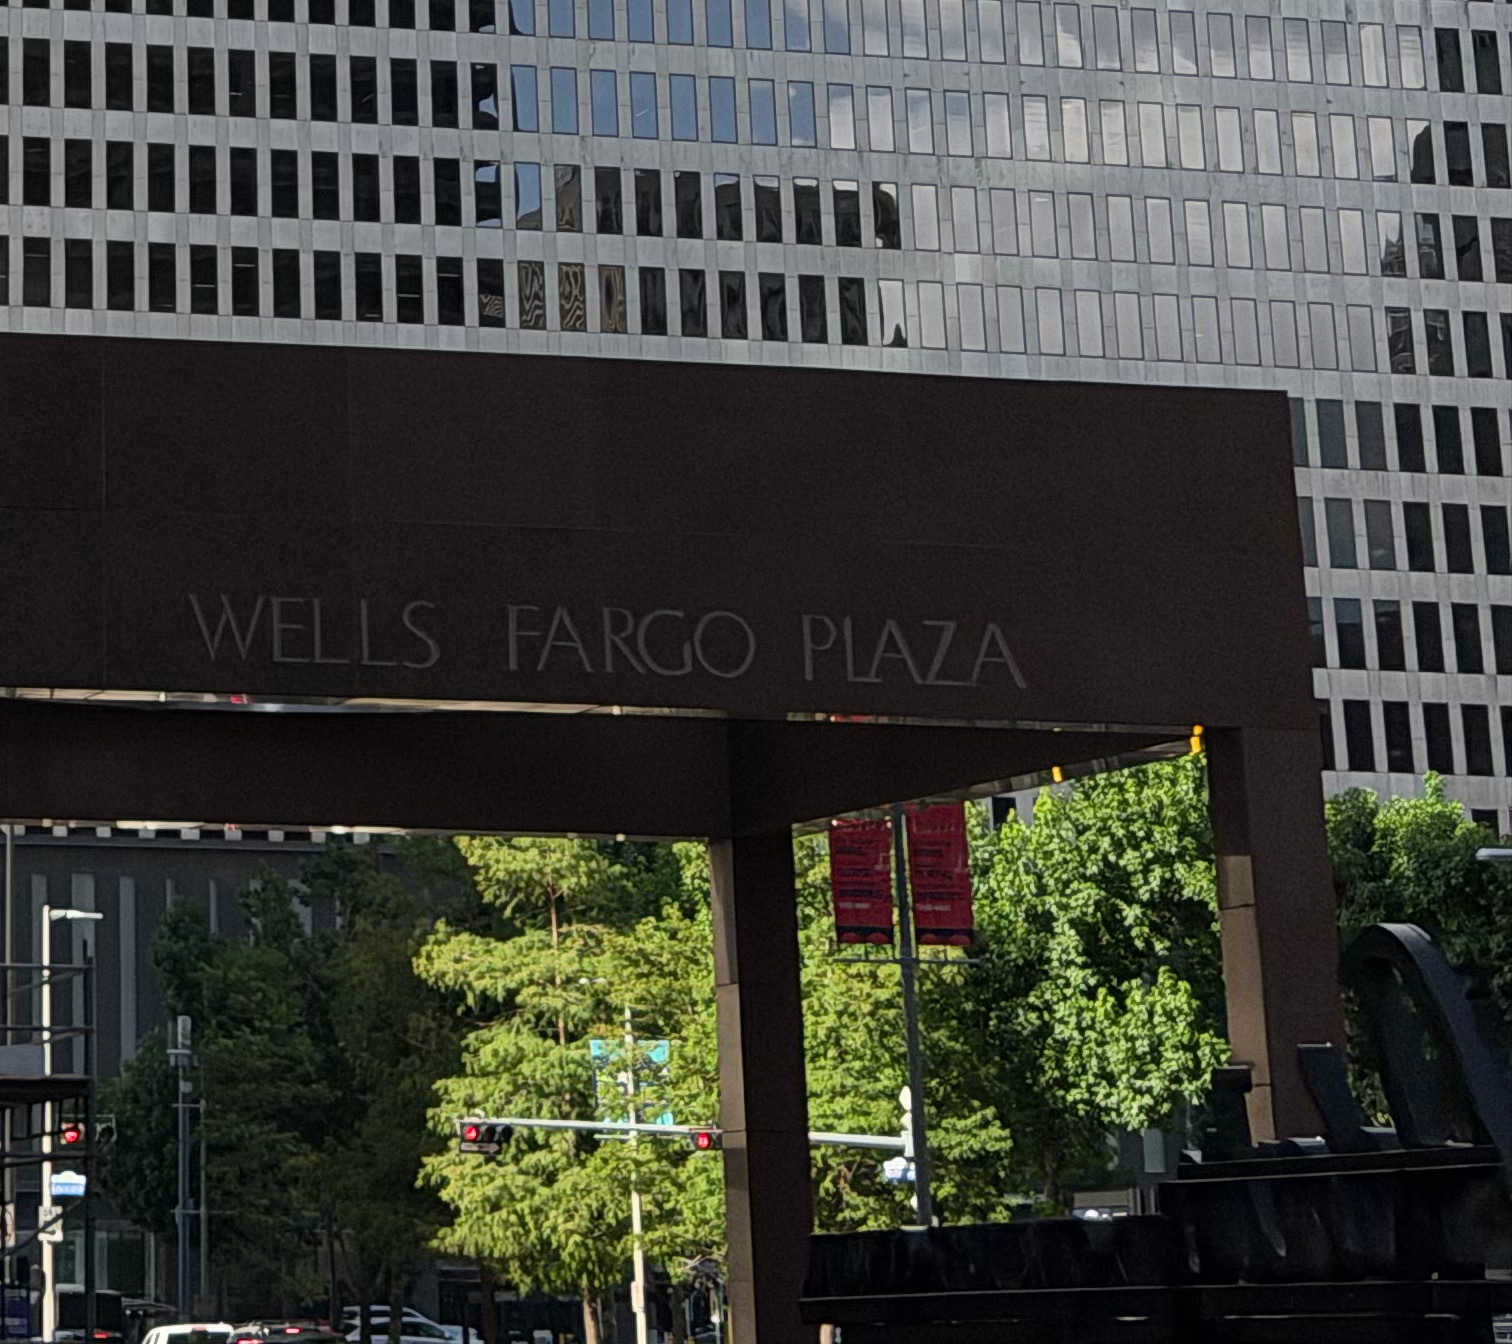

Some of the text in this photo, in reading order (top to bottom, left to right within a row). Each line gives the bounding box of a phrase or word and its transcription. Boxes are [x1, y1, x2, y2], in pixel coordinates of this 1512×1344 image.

[188, 592, 1028, 690] WELLS FARGO PLAZA
